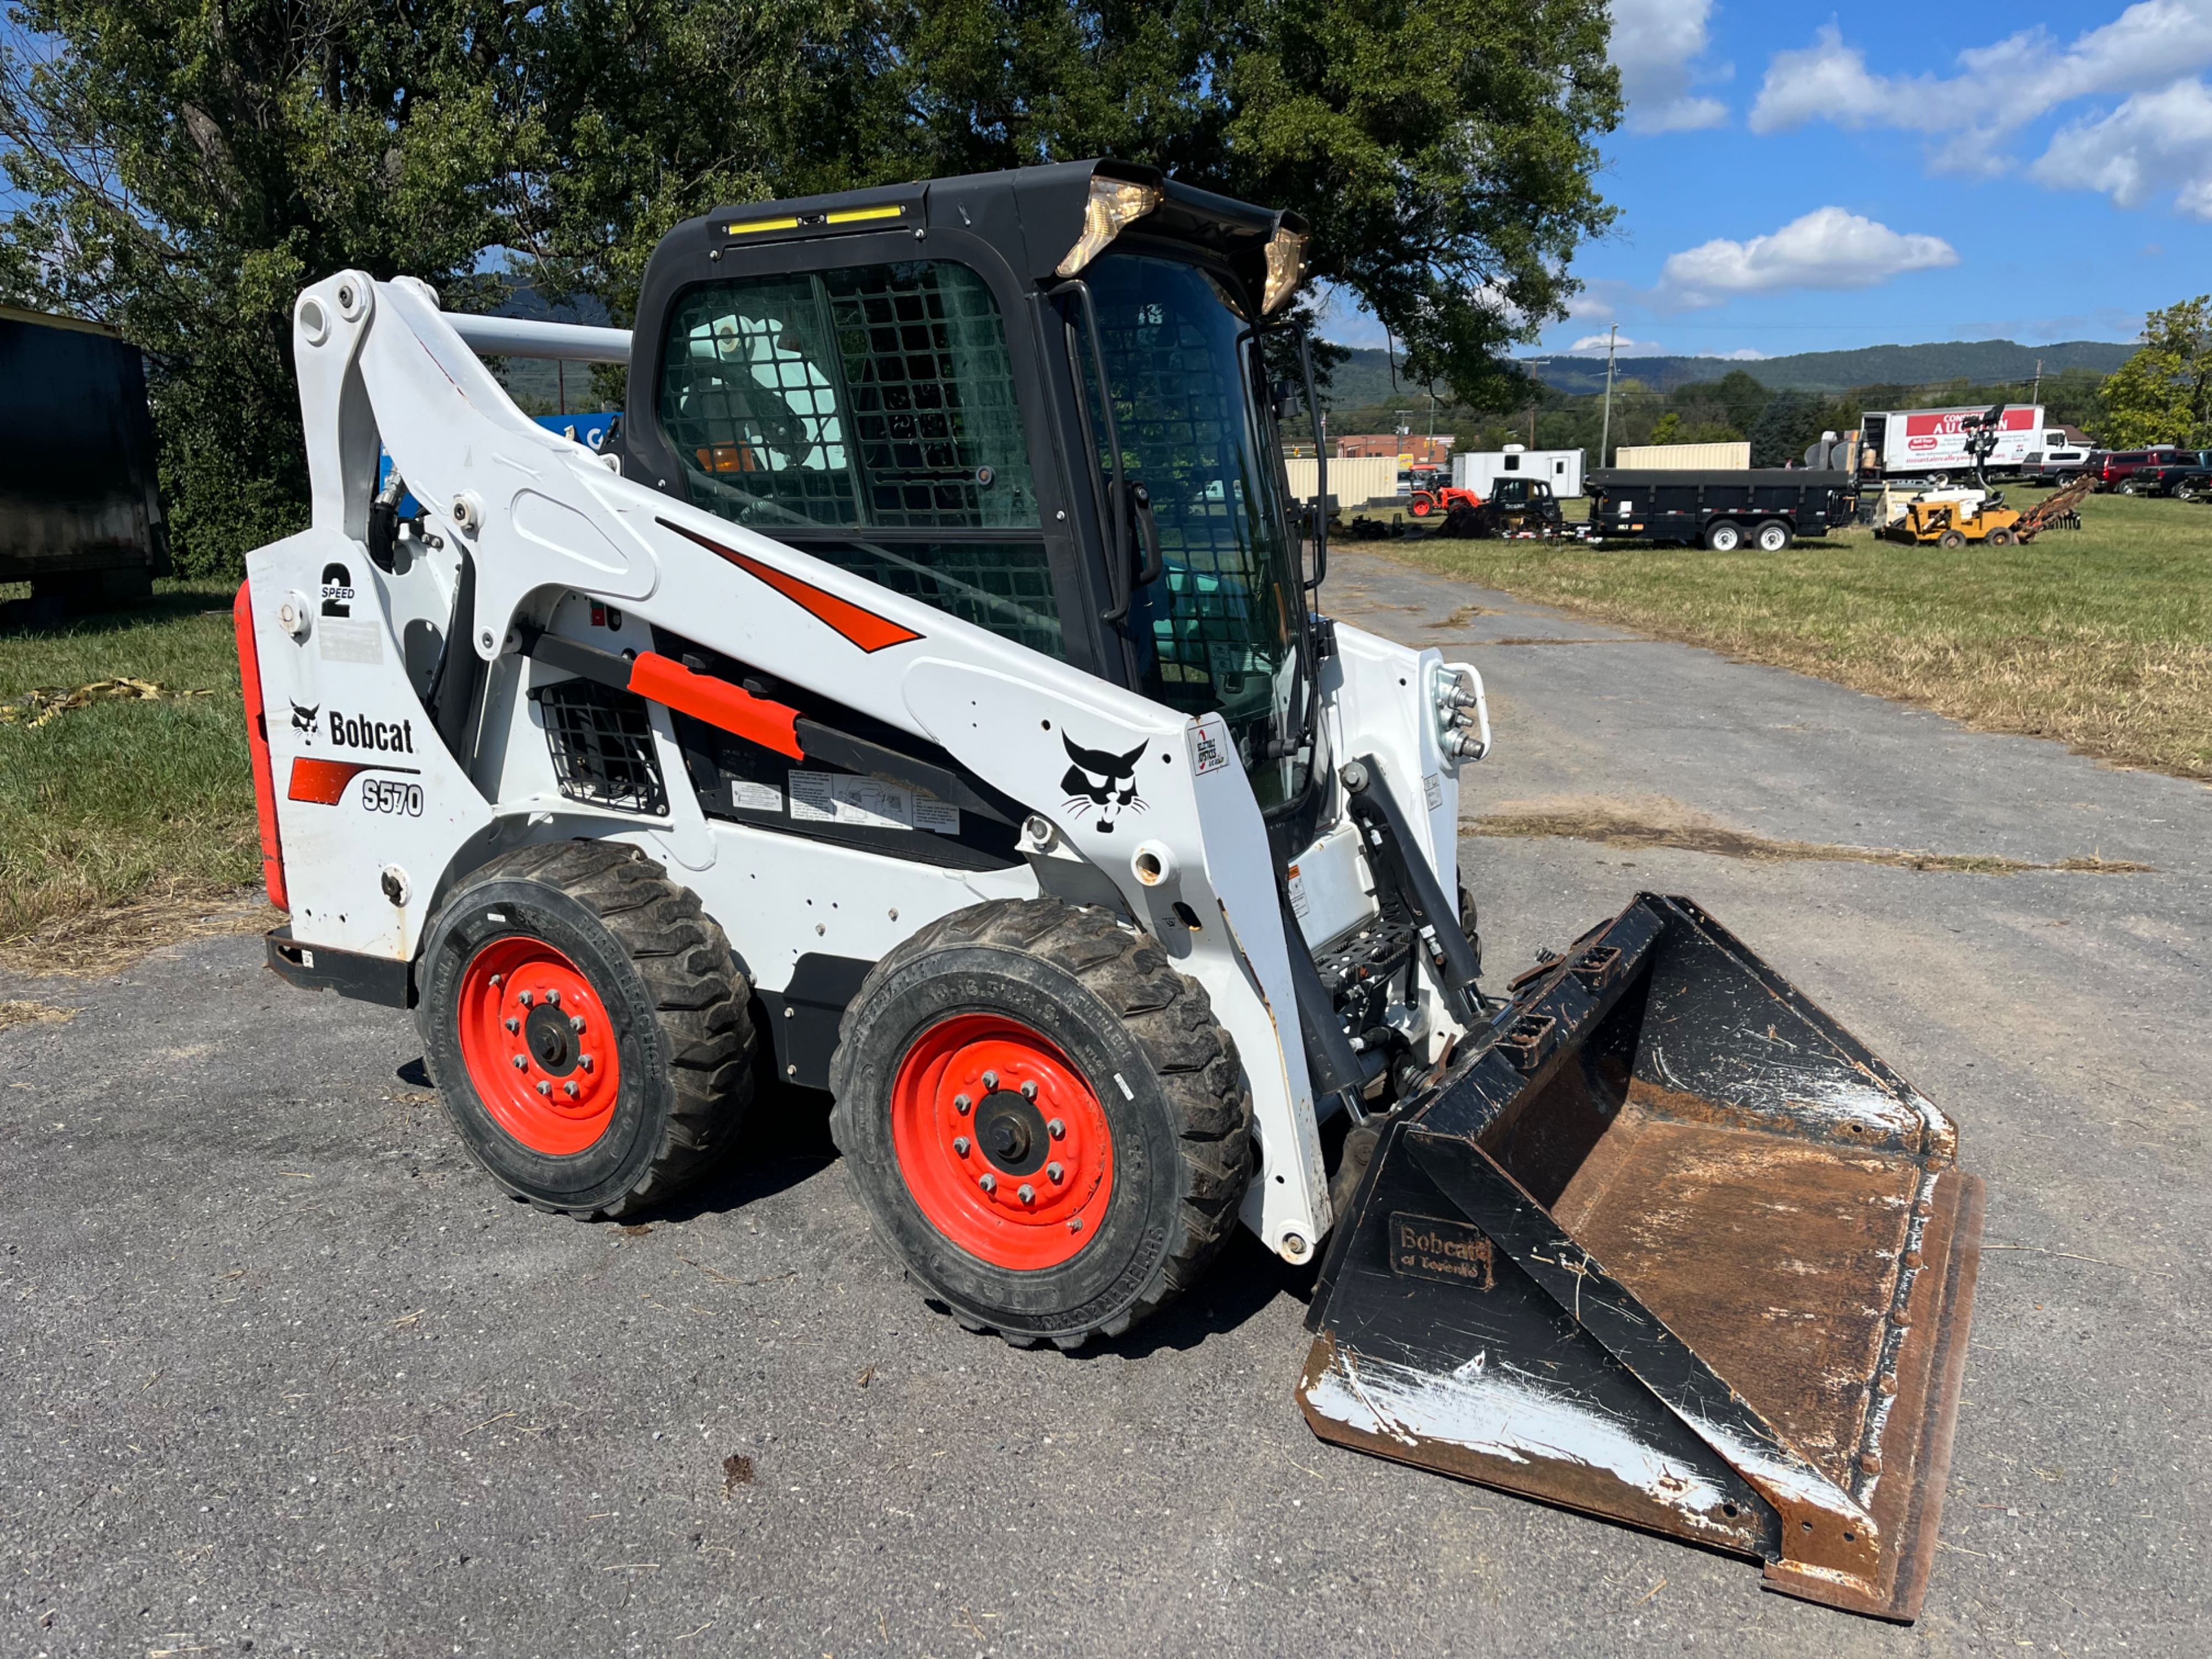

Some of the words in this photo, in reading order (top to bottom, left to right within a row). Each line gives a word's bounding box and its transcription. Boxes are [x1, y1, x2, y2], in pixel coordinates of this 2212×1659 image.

[322, 586, 355, 599] SPEED
[328, 711, 414, 754] Bobcat
[362, 779, 424, 817] S570
[1401, 1225, 1479, 1261] Bobcat
